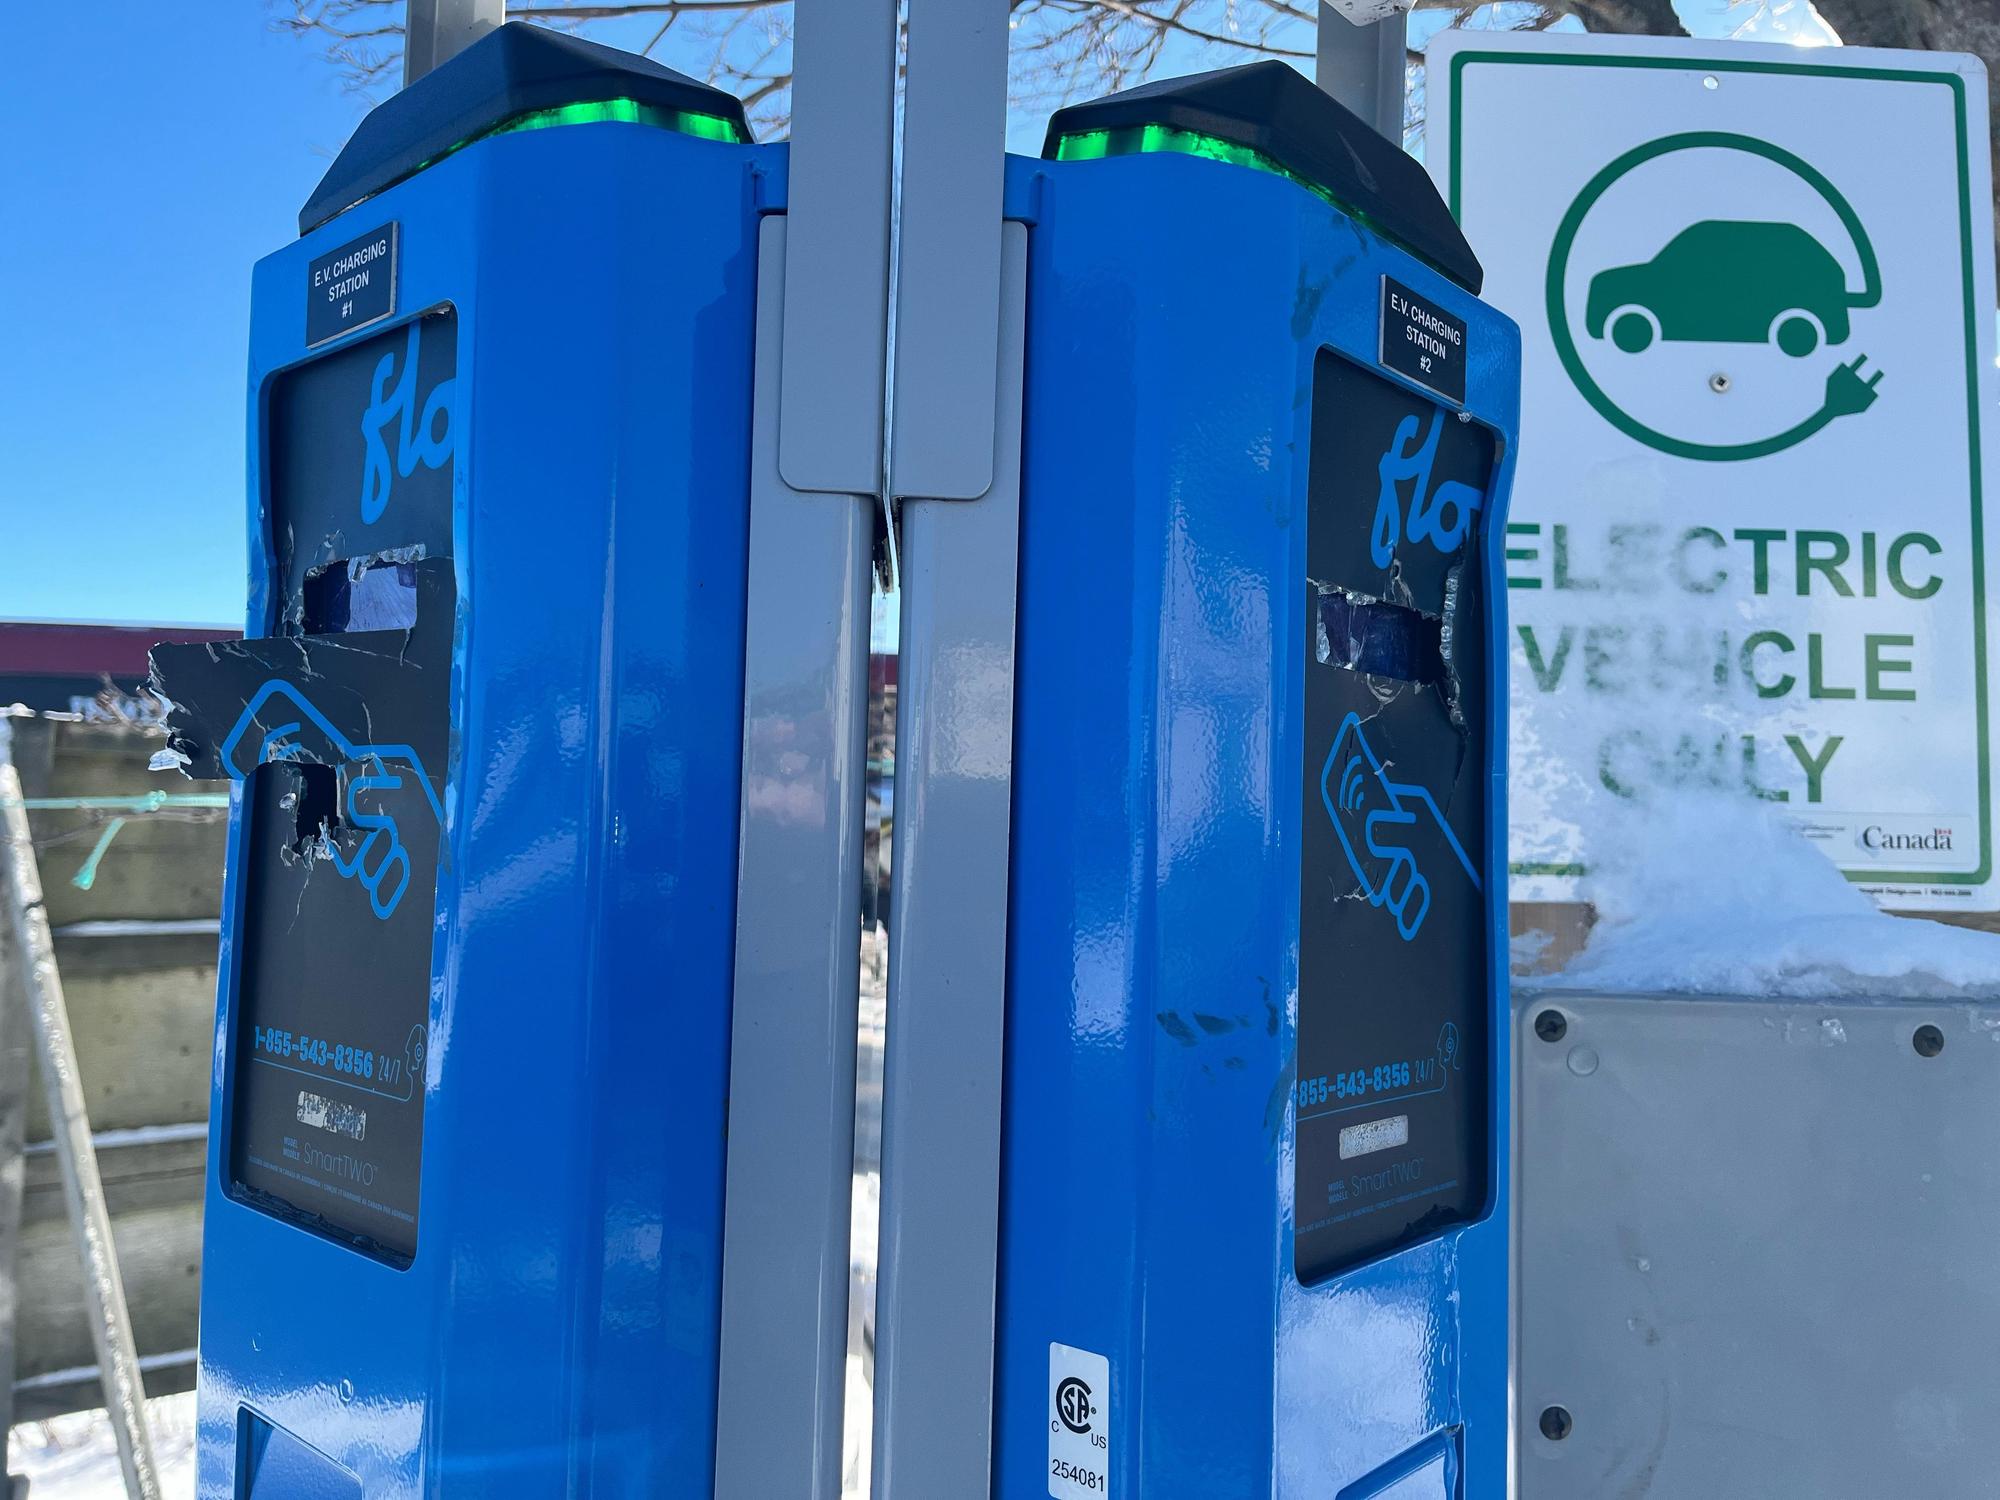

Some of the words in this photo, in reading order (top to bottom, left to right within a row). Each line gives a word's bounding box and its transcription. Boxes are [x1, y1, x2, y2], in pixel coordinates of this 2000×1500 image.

[314, 266, 331, 287] E.V.
[333, 239, 387, 278] CHARGING
[328, 270, 370, 302] STATION
[341, 300, 353, 318] #1
[1391, 293, 1409, 317] E.V.
[1411, 305, 1461, 346] CHARGING
[1406, 325, 1446, 360] STATION
[1420, 355, 1432, 374] #2
[1370, 404, 1484, 570] flo
[1862, 825, 1953, 850] Canada
[254, 1025, 374, 1079] 1-855-543-8356
[377, 1055, 402, 1086] 24/7
[1298, 1062, 1411, 1107] 855-543-8356
[1415, 1057, 1435, 1084] 24/7
[1051, 1420, 1060, 1433] C
[1091, 1432, 1107, 1449] US
[1051, 1458, 1104, 1492] 254081
